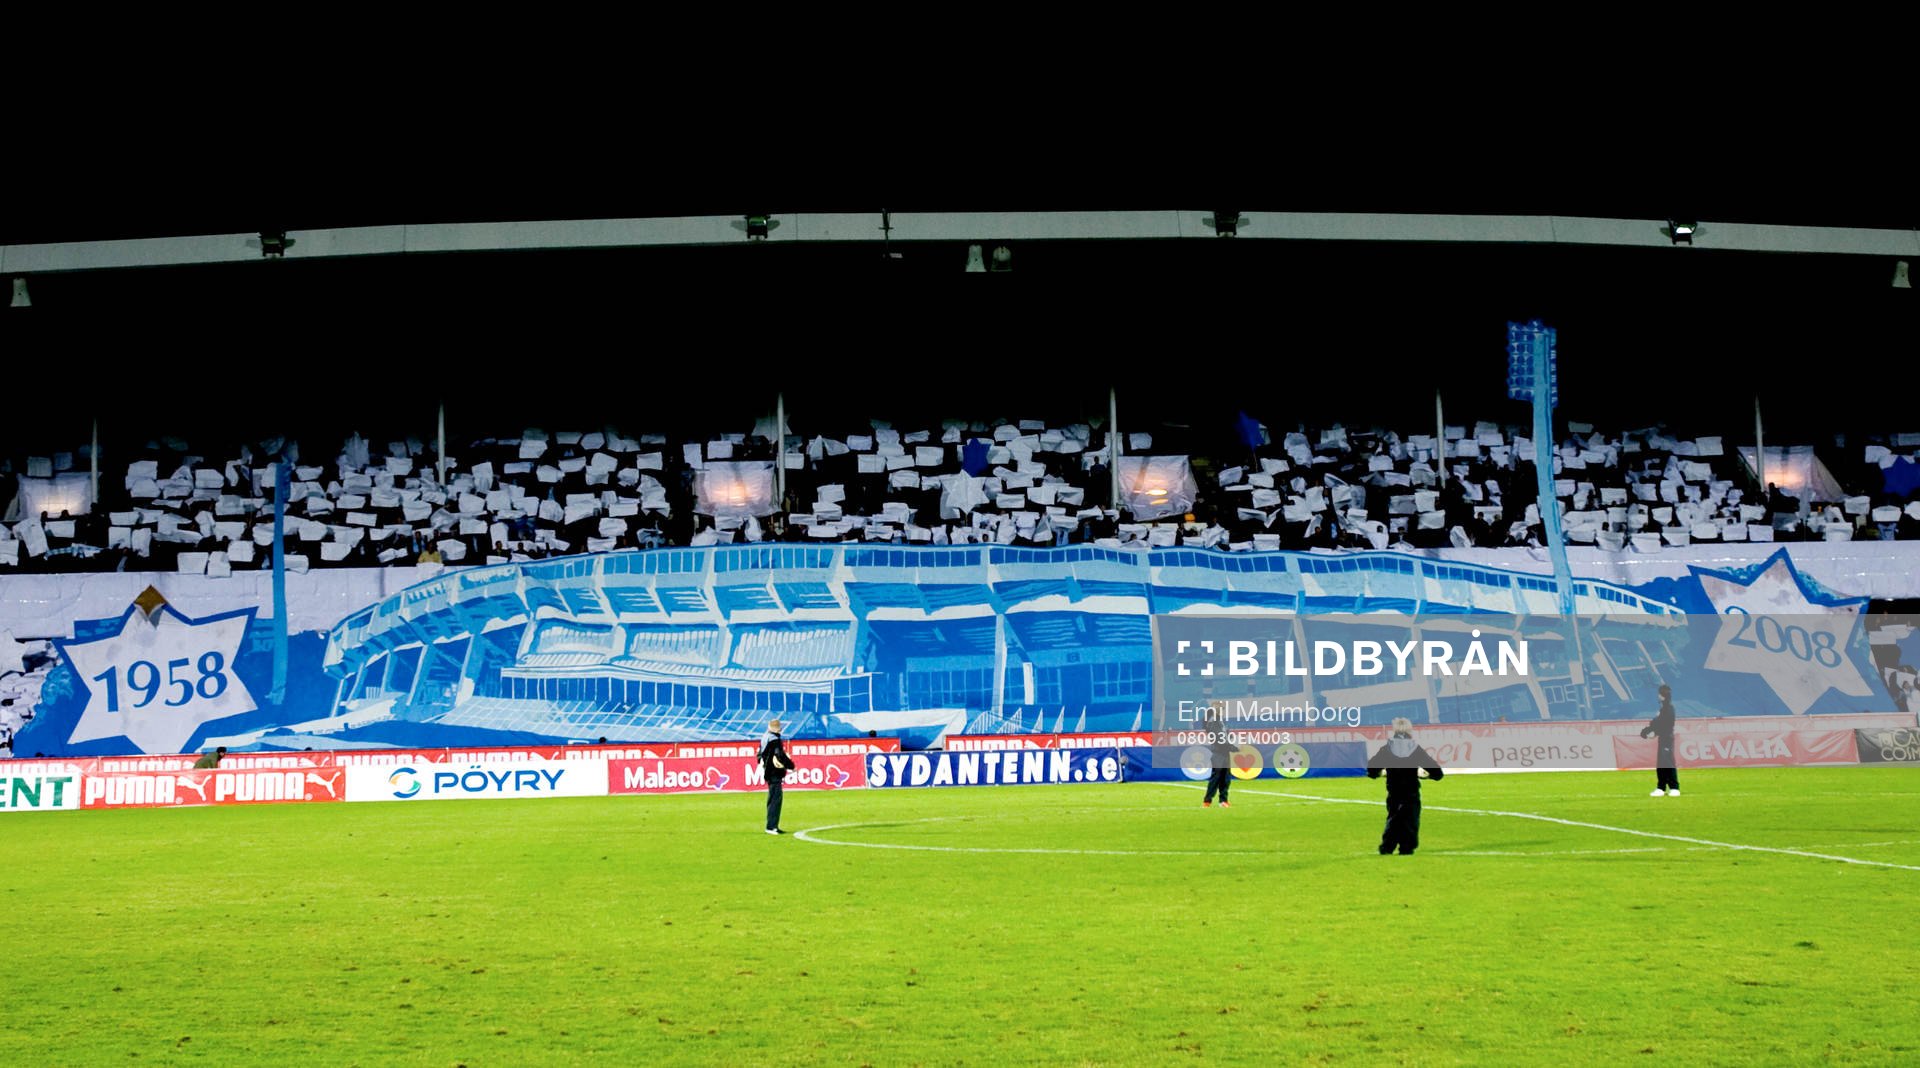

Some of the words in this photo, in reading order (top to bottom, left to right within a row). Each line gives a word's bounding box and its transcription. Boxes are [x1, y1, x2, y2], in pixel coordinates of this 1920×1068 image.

[1724, 605, 1842, 668] 2008
[93, 651, 228, 712] 1958
[1491, 740, 1594, 767] pagen.se
[434, 764, 565, 793] PÖYRY
[624, 761, 703, 789] Malaco
[745, 763, 824, 785] Maco
[869, 750, 1118, 787] SYDANTENN.se
[85, 776, 176, 805] PUMA
[214, 772, 305, 802] PUMA
